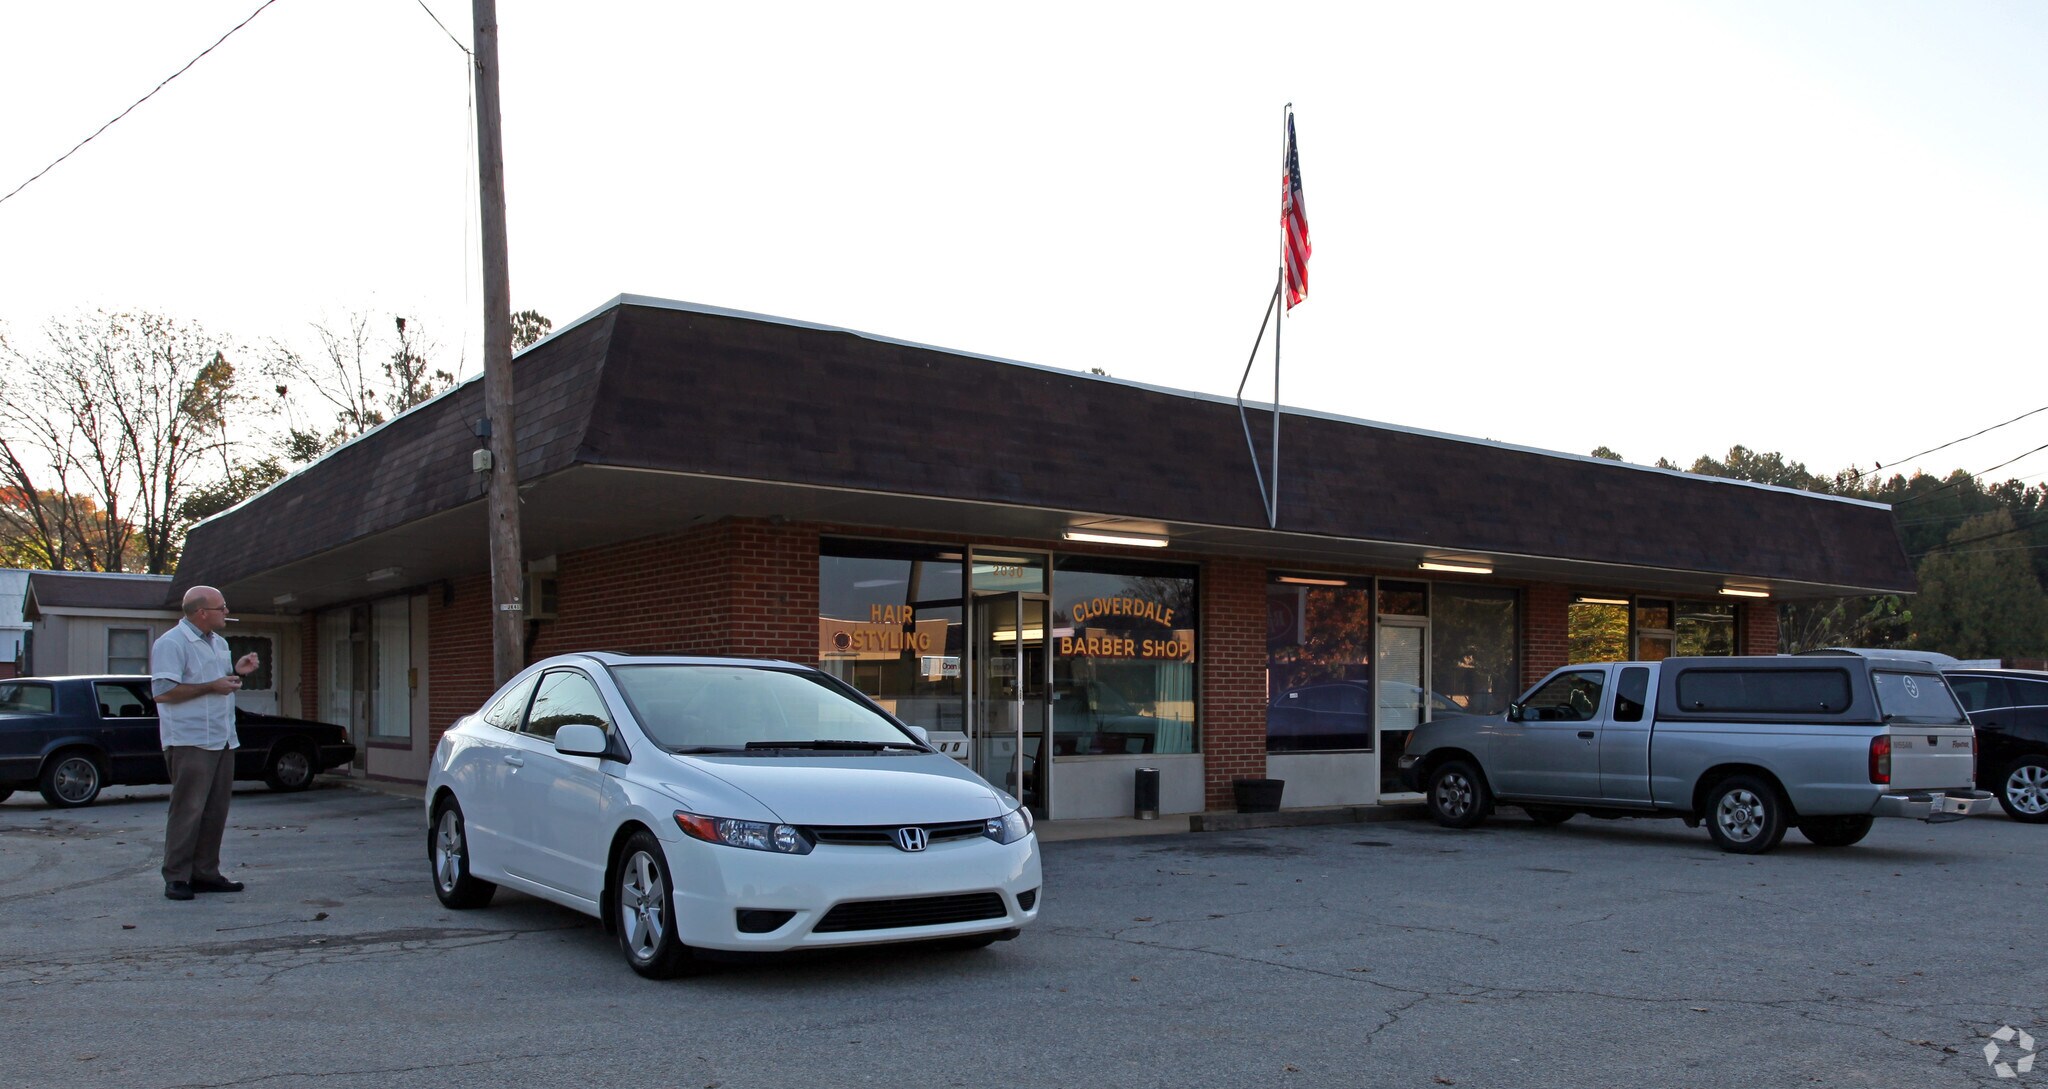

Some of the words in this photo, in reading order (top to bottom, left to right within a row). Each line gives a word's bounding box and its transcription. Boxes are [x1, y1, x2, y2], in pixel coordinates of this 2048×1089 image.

[993, 564, 1023, 578] 2030
[871, 603, 913, 624] HAIR
[1072, 597, 1174, 627] CLOVERDALE
[852, 630, 931, 651] STYLING
[1061, 636, 1136, 657] BARBER
[1142, 639, 1191, 658] SHOP
[942, 662, 957, 671] Open
